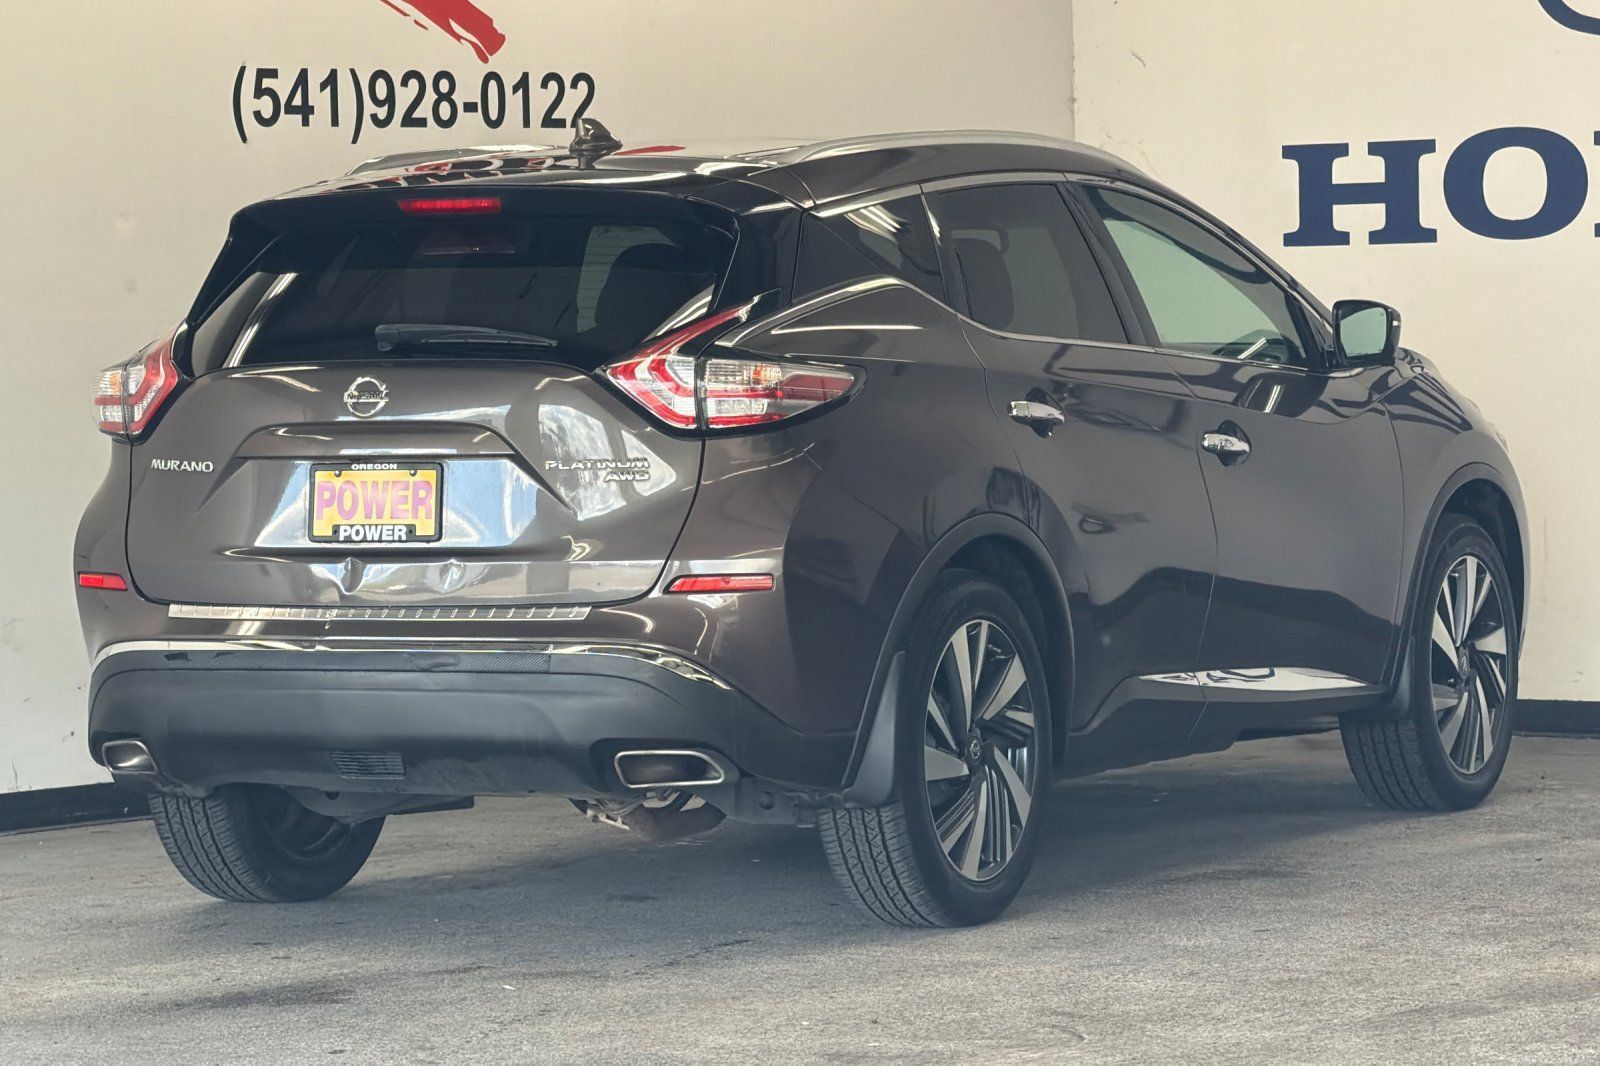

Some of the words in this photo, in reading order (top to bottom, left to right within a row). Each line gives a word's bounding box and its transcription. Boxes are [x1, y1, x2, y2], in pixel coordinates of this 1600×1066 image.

[232, 65, 596, 144] (541)928-0122
[1281, 126, 1600, 248] HO
[150, 458, 214, 472] MURANO
[544, 458, 650, 470] PLATINUM
[603, 471, 650, 482] AWD
[316, 480, 433, 520] POWER
[338, 525, 407, 541] POWER
